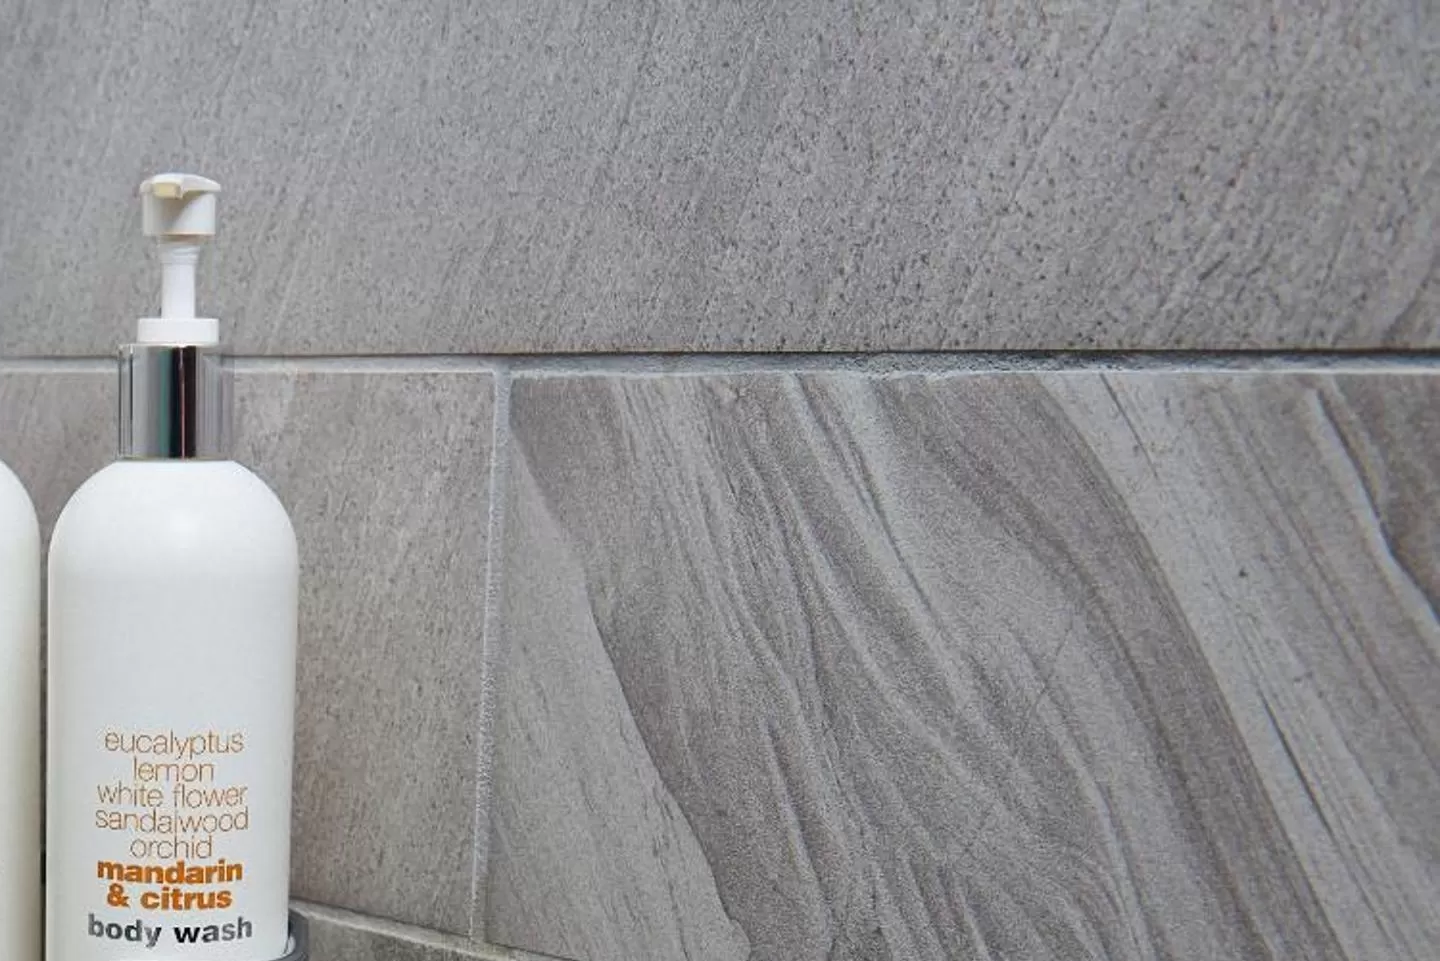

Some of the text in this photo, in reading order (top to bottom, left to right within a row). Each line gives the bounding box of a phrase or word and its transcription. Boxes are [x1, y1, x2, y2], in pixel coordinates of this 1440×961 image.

[104, 729, 245, 760] eucalyptus
[134, 757, 215, 782] lemon
[97, 781, 248, 809] white flower
[95, 807, 250, 834] sandalwood
[130, 835, 213, 859] orchid
[97, 858, 243, 884] mandarin
[106, 882, 233, 911] & citrus
[88, 913, 253, 947] body wash
